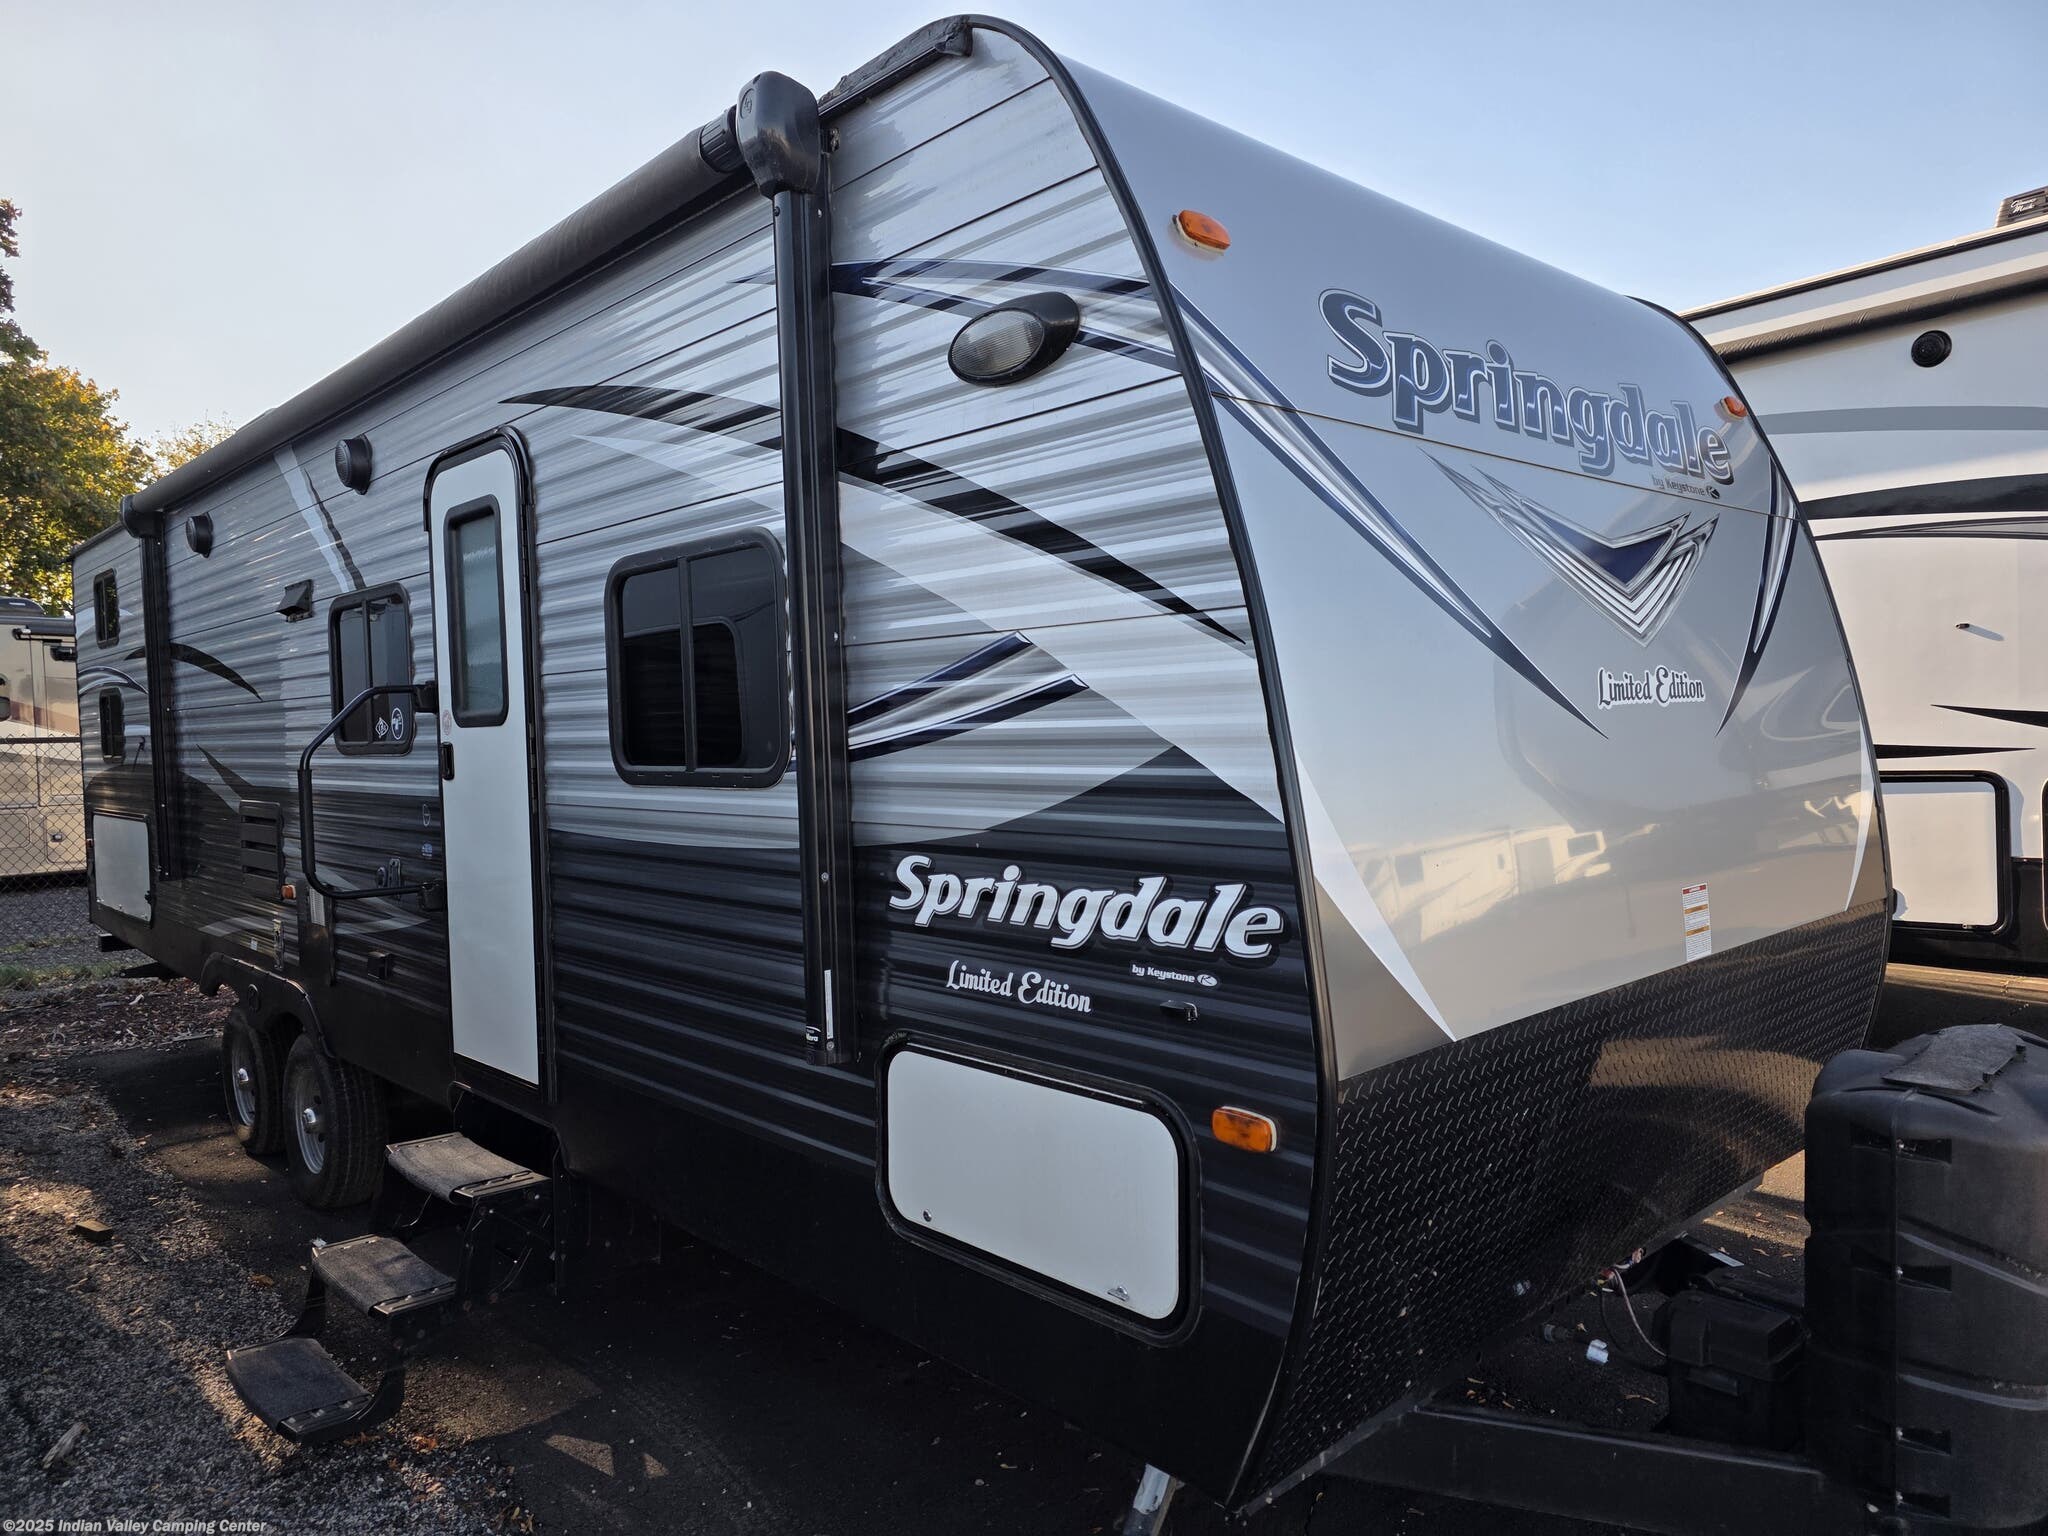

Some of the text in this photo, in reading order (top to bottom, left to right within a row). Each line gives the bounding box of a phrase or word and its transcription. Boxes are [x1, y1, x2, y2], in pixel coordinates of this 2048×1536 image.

[1318, 287, 1734, 485] Springdale
[1651, 474, 1706, 495] by Keystone
[1598, 665, 1705, 707] Limited Edition
[888, 855, 1284, 959] Springdale
[946, 959, 1092, 1013] Limited Edition
[1131, 963, 1145, 977] by
[1147, 966, 1196, 983] Keystone
